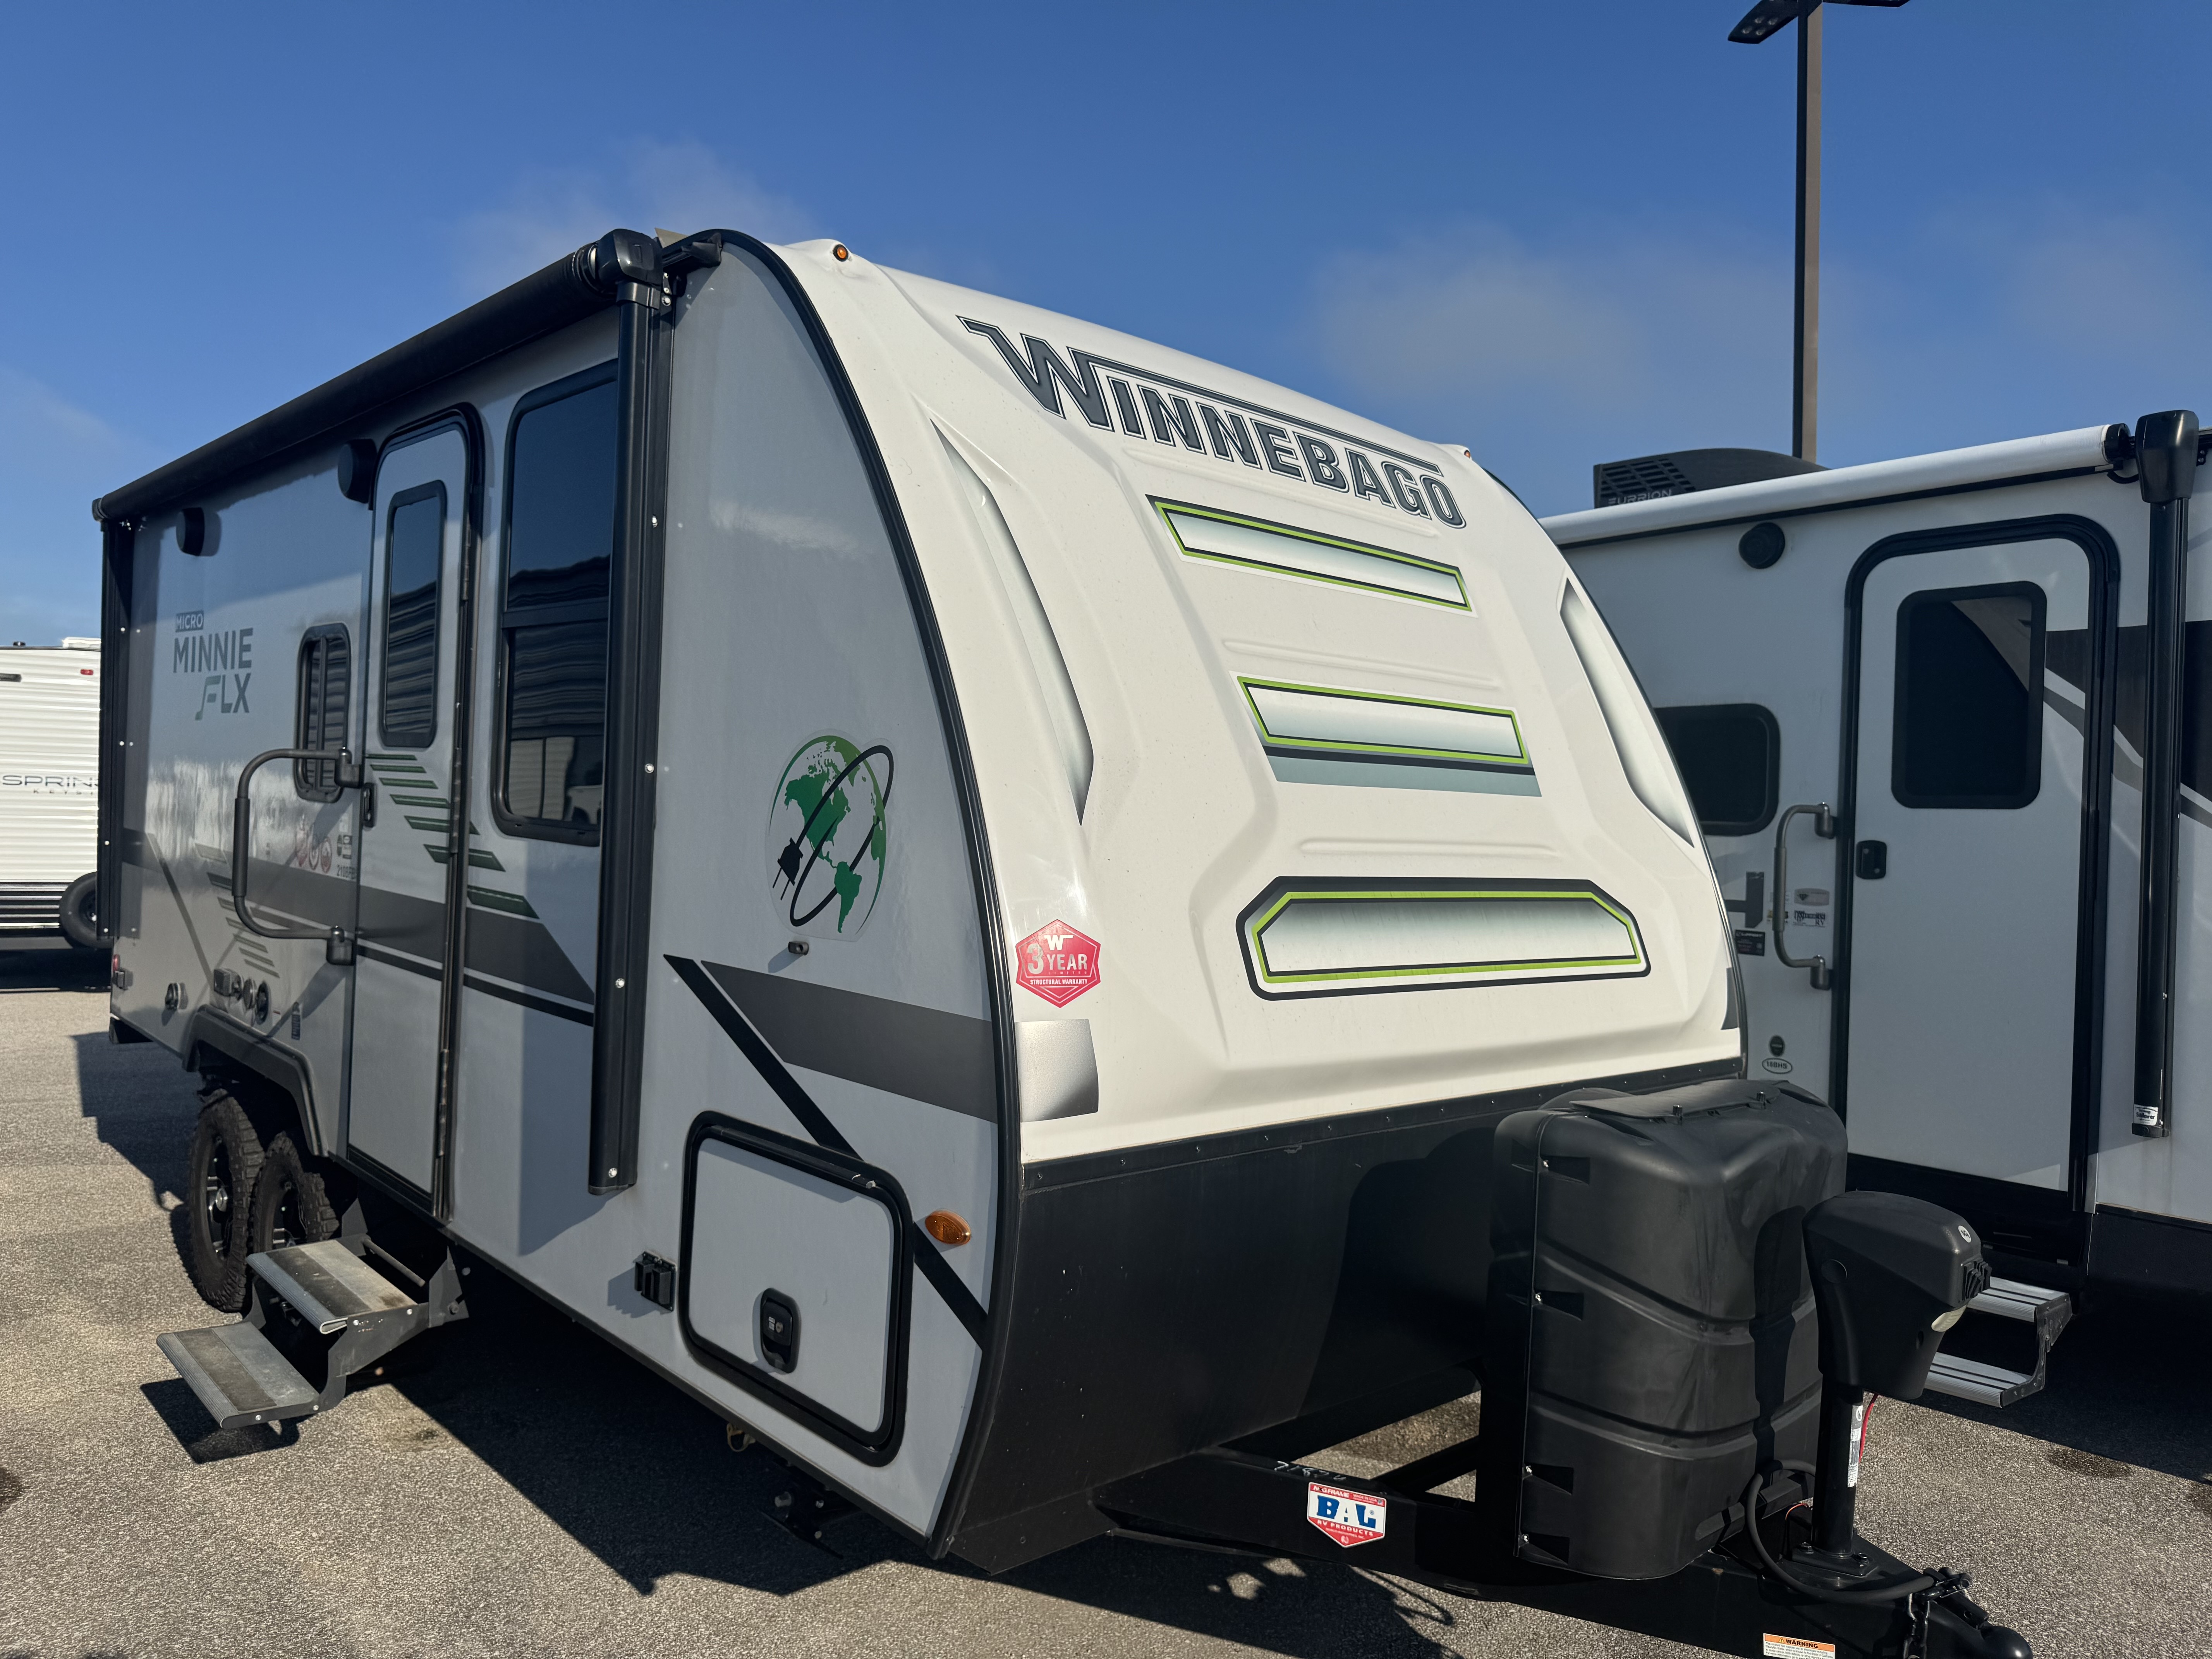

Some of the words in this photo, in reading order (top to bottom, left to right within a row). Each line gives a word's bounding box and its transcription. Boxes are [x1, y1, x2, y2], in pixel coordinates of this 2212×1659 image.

[955, 314, 1467, 529] WINNEBAGO
[175, 613, 204, 630] MICRO
[173, 627, 253, 673] MINNIE
[195, 672, 251, 721] FLX
[2, 775, 99, 787] SPRIN
[1027, 943, 1044, 974] 3
[1046, 954, 1088, 970] YEAR
[1317, 1495, 1376, 1529] BAL
[1330, 1522, 1374, 1537] PRODUCTS
[1786, 1639, 1818, 1649] WARNING
